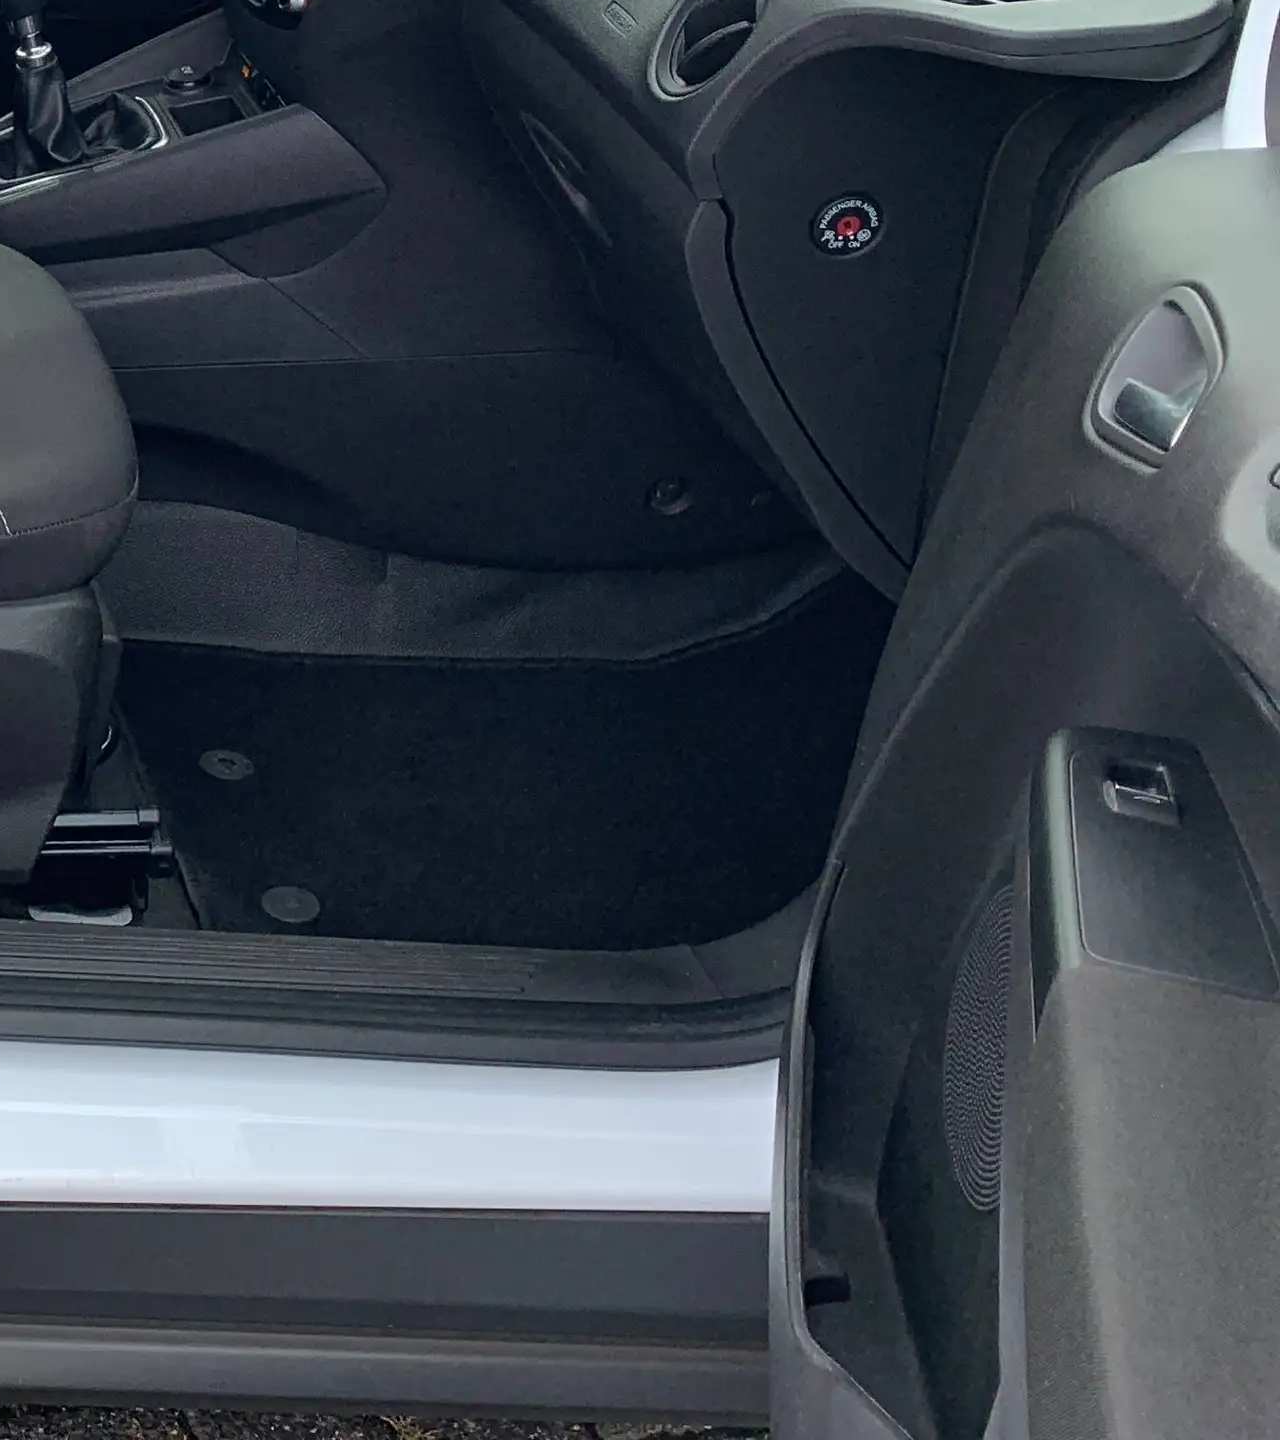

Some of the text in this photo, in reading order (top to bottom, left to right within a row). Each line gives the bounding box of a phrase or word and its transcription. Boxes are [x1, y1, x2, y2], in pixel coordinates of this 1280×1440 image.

[819, 200, 879, 229] PASSENGER AIRBAG
[828, 241, 844, 249] OFF
